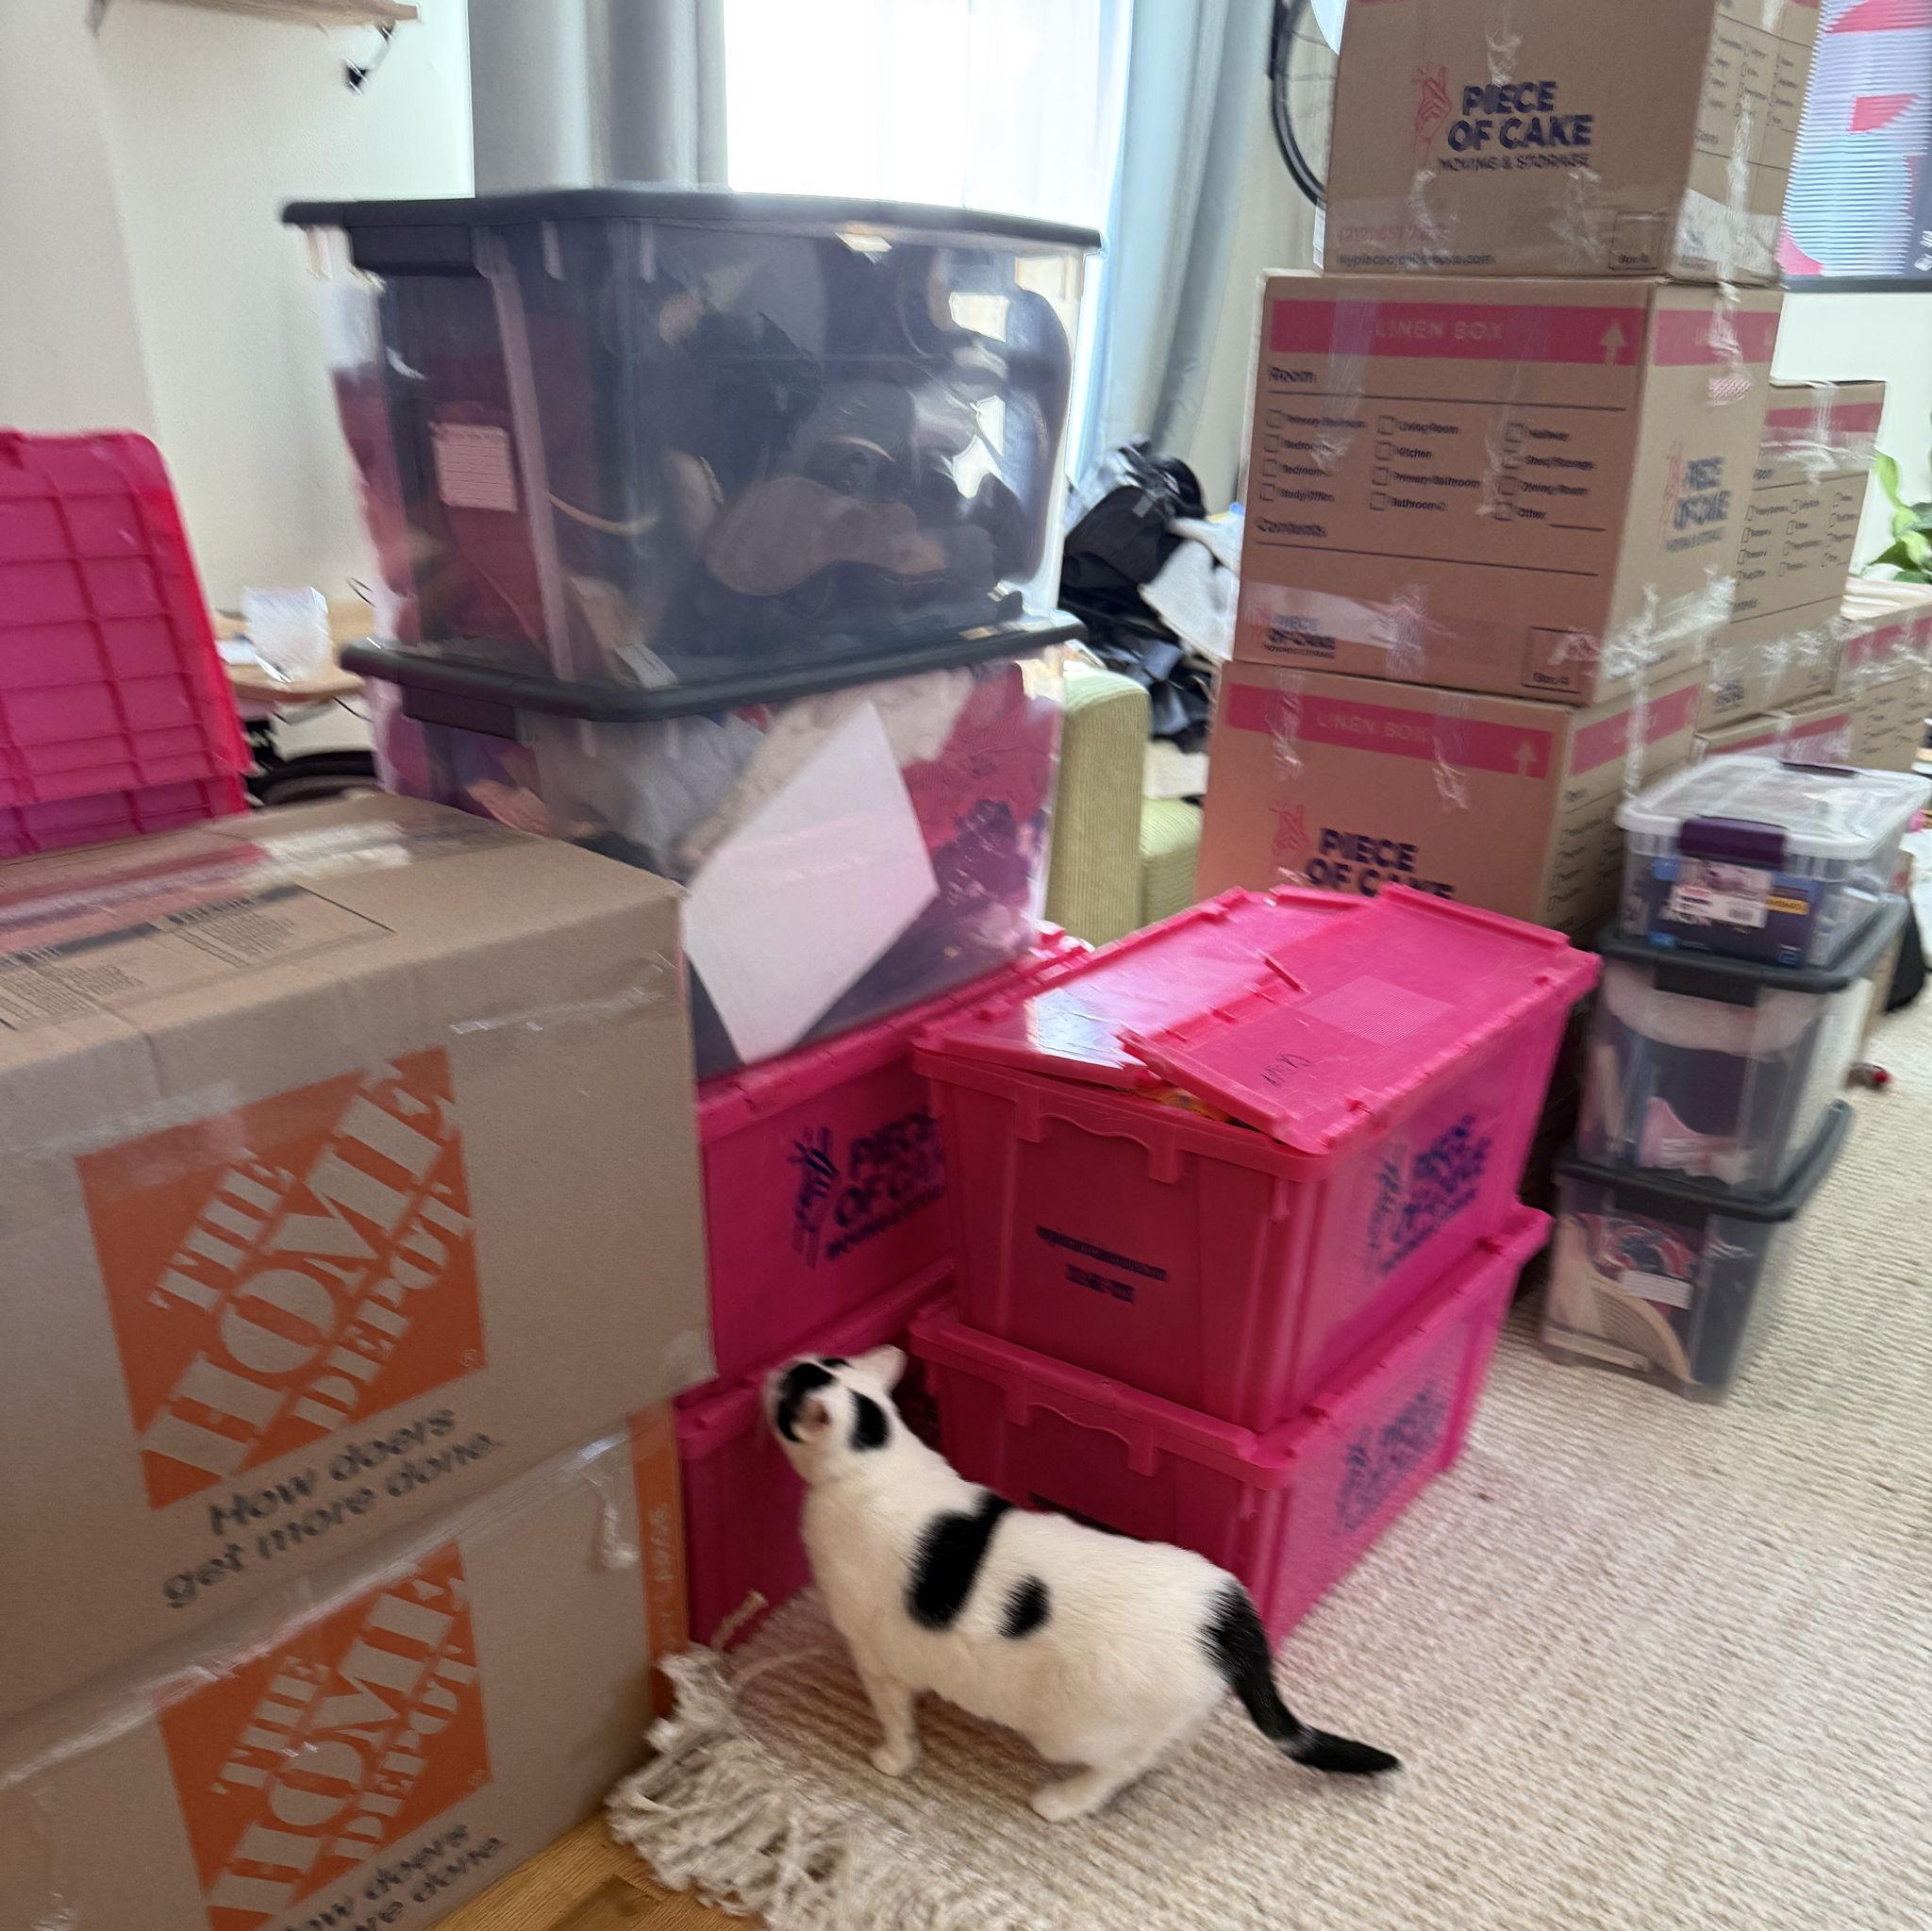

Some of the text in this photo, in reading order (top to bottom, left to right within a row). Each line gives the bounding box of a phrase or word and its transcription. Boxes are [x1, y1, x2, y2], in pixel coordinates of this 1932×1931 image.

[1448, 114, 1593, 152] OF CAKE
[1463, 81, 1556, 116] PIECE
[1375, 320, 1504, 341] LINEN BOX
[1395, 447, 1433, 459] Kitchen
[1431, 474, 1481, 489] Bathroom
[1306, 857, 1352, 890] OF
[1320, 827, 1418, 873] PIECE
[141, 1060, 460, 1482] HOME
[148, 1148, 297, 1315] THE
[291, 1181, 474, 1432] DEPOT
[209, 1409, 456, 1536] How doers
[162, 1543, 244, 1609] get
[255, 1487, 375, 1560] more
[206, 1576, 467, 1915] HOME
[210, 1653, 330, 1795] THE
[331, 1643, 477, 1862] DEPOT
[363, 1824, 469, 1901] doers
